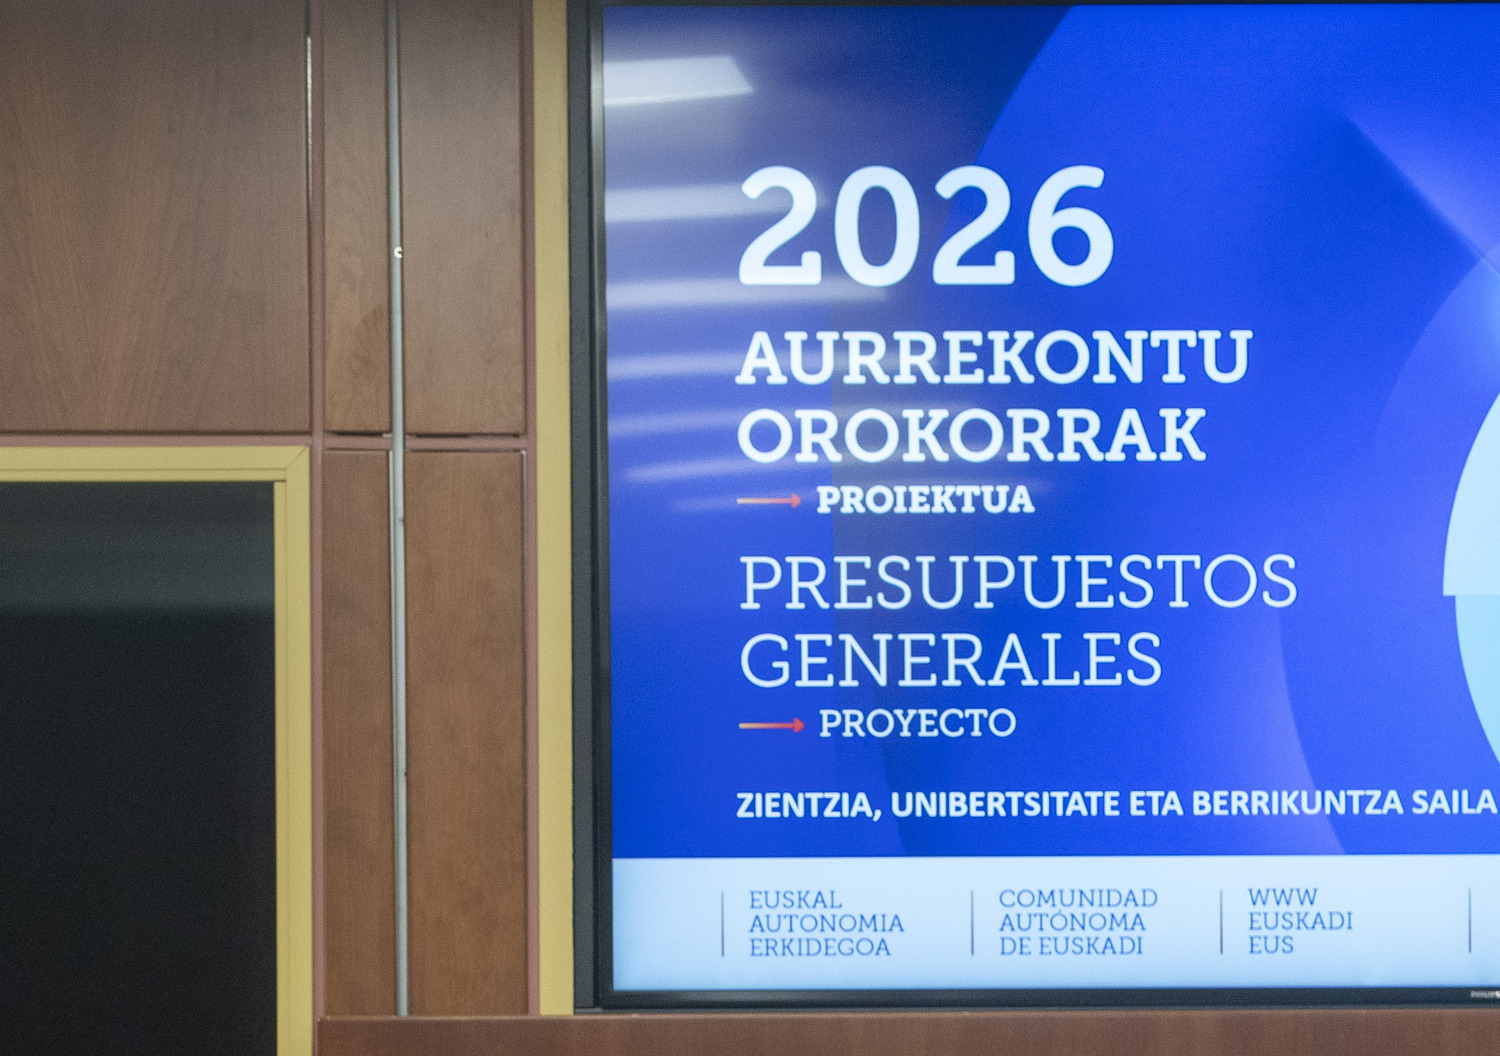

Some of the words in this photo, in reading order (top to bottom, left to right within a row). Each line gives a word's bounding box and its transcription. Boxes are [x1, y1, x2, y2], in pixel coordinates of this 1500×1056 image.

[739, 165, 1114, 287] 2026
[735, 329, 1253, 385] AURREKONTU
[737, 407, 1206, 463] OROKORRAK
[816, 484, 1035, 514] PROIEKTUA
[739, 553, 1297, 610] PRESUPUESTOS
[740, 631, 1162, 688] GENERALES
[819, 707, 1017, 738] PROYECTO
[736, 791, 882, 822] ZIENTZIA,
[891, 790, 1120, 818] UNIBERTSITATE
[1130, 790, 1184, 816] ETA
[1192, 789, 1404, 816] BERRIKUNTZA
[1412, 788, 1498, 815] SAILA
[750, 890, 843, 910] EUSKAL
[999, 888, 1158, 908] COMUNIDAD
[1248, 888, 1319, 907] WWW
[749, 913, 905, 933] AUTONOMIA
[999, 907, 1146, 932] AUTÓNOMA
[1249, 911, 1353, 931] EUSKADI
[750, 937, 892, 957] ERKIDEGOA
[1000, 936, 1032, 956] DE
[1039, 936, 1143, 956] EUSKADI
[1249, 935, 1294, 955] EUS
